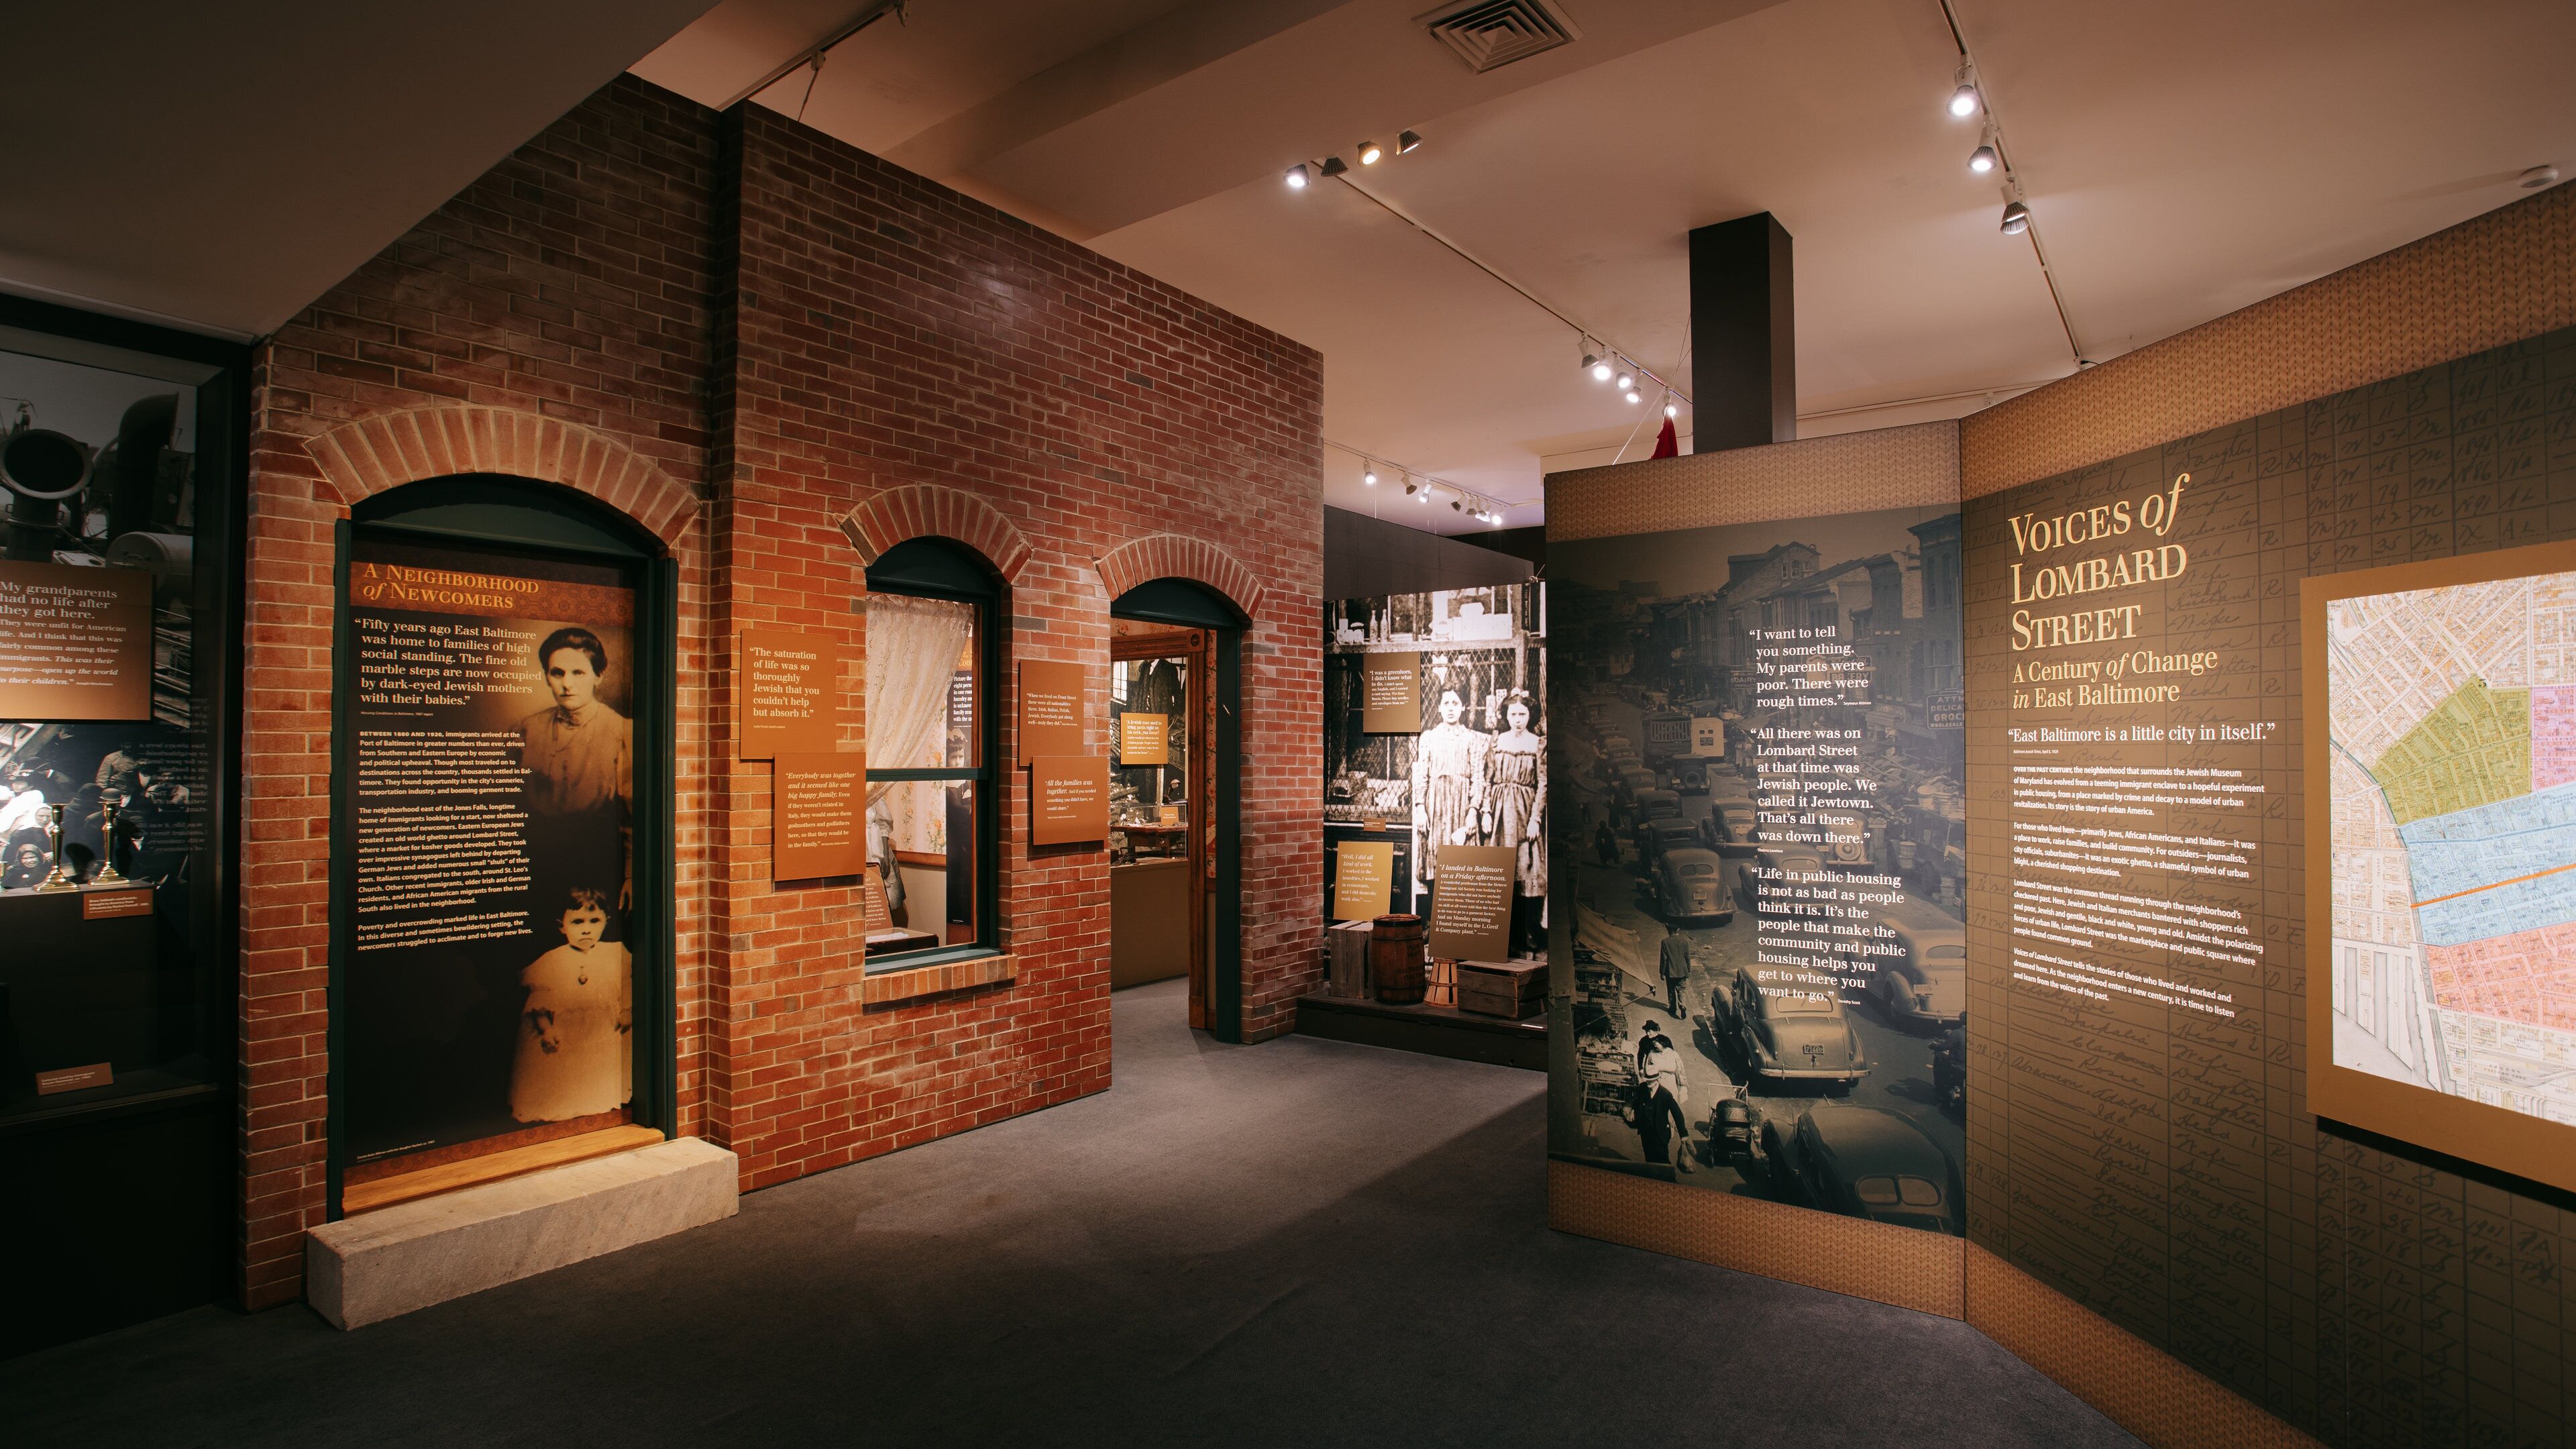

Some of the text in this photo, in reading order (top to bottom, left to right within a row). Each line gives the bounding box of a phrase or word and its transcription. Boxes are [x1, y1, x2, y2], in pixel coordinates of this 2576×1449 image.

[2008, 473, 2190, 554] VOICES of
[363, 564, 539, 592] A NEIGHBORHOOD
[2010, 544, 2186, 604] LOMBARD
[0, 581, 117, 598] My grandparents
[363, 583, 513, 608] of NEWCOMERS
[0, 593, 25, 603] had
[53, 596, 74, 606] life
[78, 599, 110, 608] after
[0, 604, 95, 619] they got here.
[355, 618, 536, 639] “Fifty years ago East Baltimore
[1749, 625, 1835, 640] “I want to tell
[2012, 604, 2141, 650] STREET
[749, 647, 816, 659] “The saturation
[1756, 643, 1854, 659] you something.
[765, 661, 778, 669] life
[1756, 661, 1864, 675] My parents were
[2012, 651, 2217, 683] A Century of Change
[753, 672, 800, 684] thoroughly
[1756, 679, 1868, 692] poor. There were
[753, 684, 819, 696] Jewish that you
[2012, 684, 2180, 708] in East Baltimore
[753, 696, 809, 706] couldn’t help
[1756, 694, 1843, 708] rough times.”
[1750, 727, 1861, 739] “All there was on
[2008, 722, 2275, 743] “East Baltimore is a little city in itself.”
[1757, 745, 1858, 755] Lombard Street
[2084, 766, 2125, 775] neighborhood
[2140, 767, 2172, 775] surrounds
[2173, 767, 2185, 775] the
[2186, 767, 2209, 776] Jewish
[2210, 768, 2241, 777] Museum
[1062, 779, 1081, 787] families
